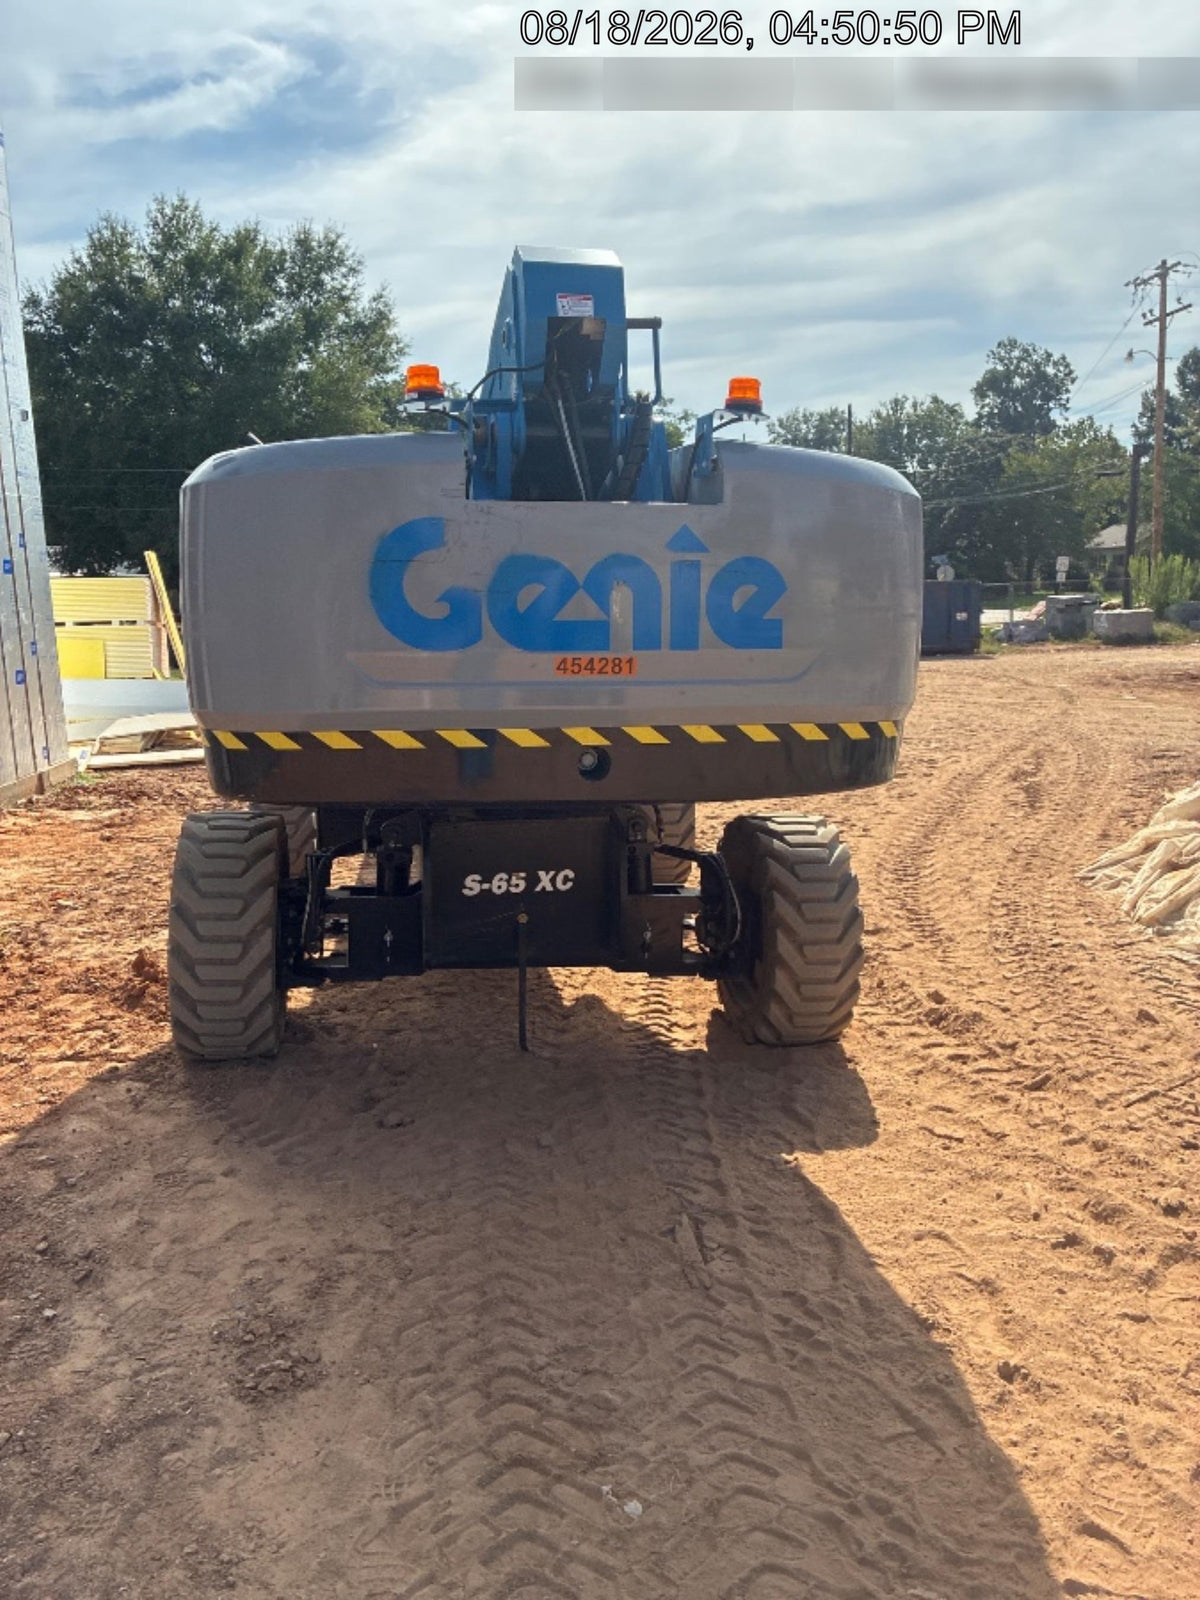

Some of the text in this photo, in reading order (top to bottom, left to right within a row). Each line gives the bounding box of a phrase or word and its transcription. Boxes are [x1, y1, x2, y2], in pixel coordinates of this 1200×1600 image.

[369, 517, 788, 652] Genie
[556, 657, 635, 675] 454281
[462, 868, 575, 897] S-65 XC
